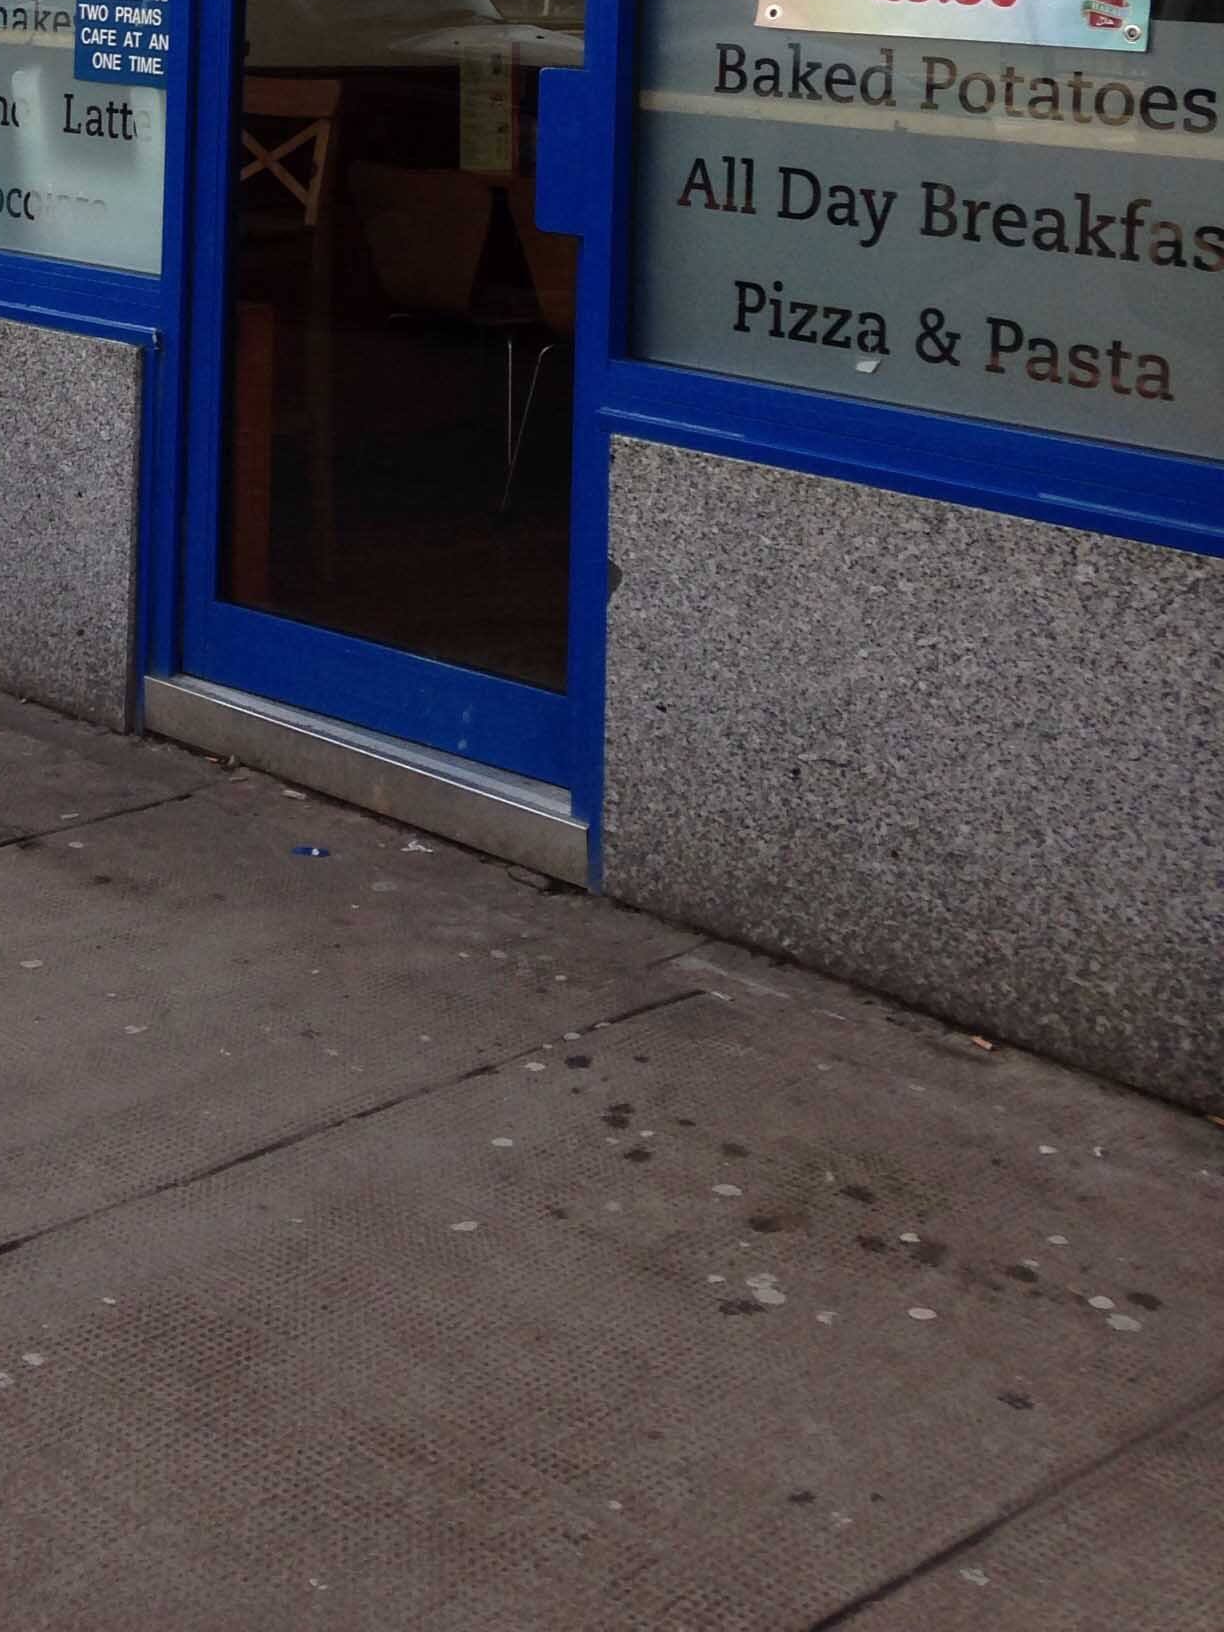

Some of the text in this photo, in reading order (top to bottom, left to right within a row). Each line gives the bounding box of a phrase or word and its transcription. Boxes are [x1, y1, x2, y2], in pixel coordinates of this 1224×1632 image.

[78, 3, 163, 26] TWO PRAMS
[80, 27, 118, 47] CAFE
[123, 30, 144, 49] AT
[91, 51, 122, 71] ONE
[713, 42, 1219, 134] Baked Potatoes
[677, 155, 1224, 273] All Day Breakfas
[732, 279, 1175, 403] Pizza & Pasta
